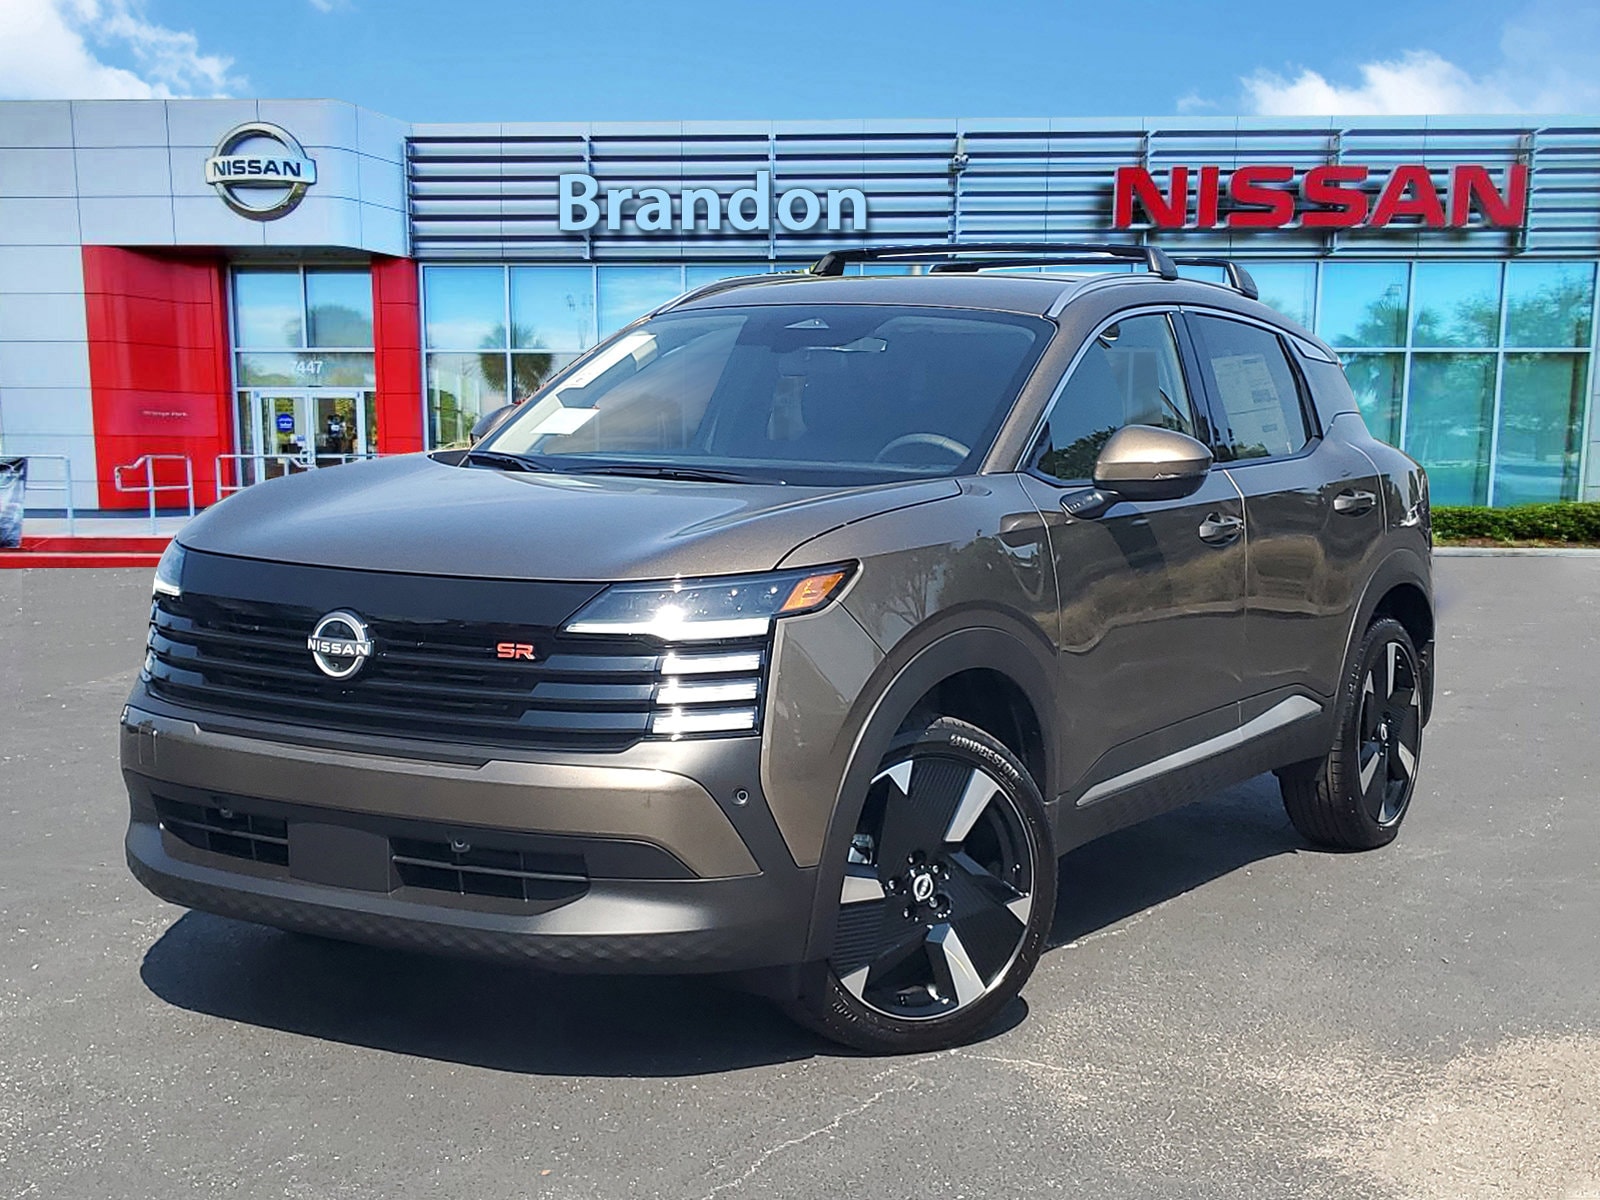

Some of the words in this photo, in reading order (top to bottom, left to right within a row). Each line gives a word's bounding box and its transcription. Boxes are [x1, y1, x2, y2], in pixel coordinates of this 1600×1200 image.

[213, 159, 301, 177] NISSAN
[559, 170, 867, 232] Brandon
[1112, 165, 1528, 228] NISSAN
[307, 638, 369, 656] NISSAN
[497, 643, 535, 660] SR
